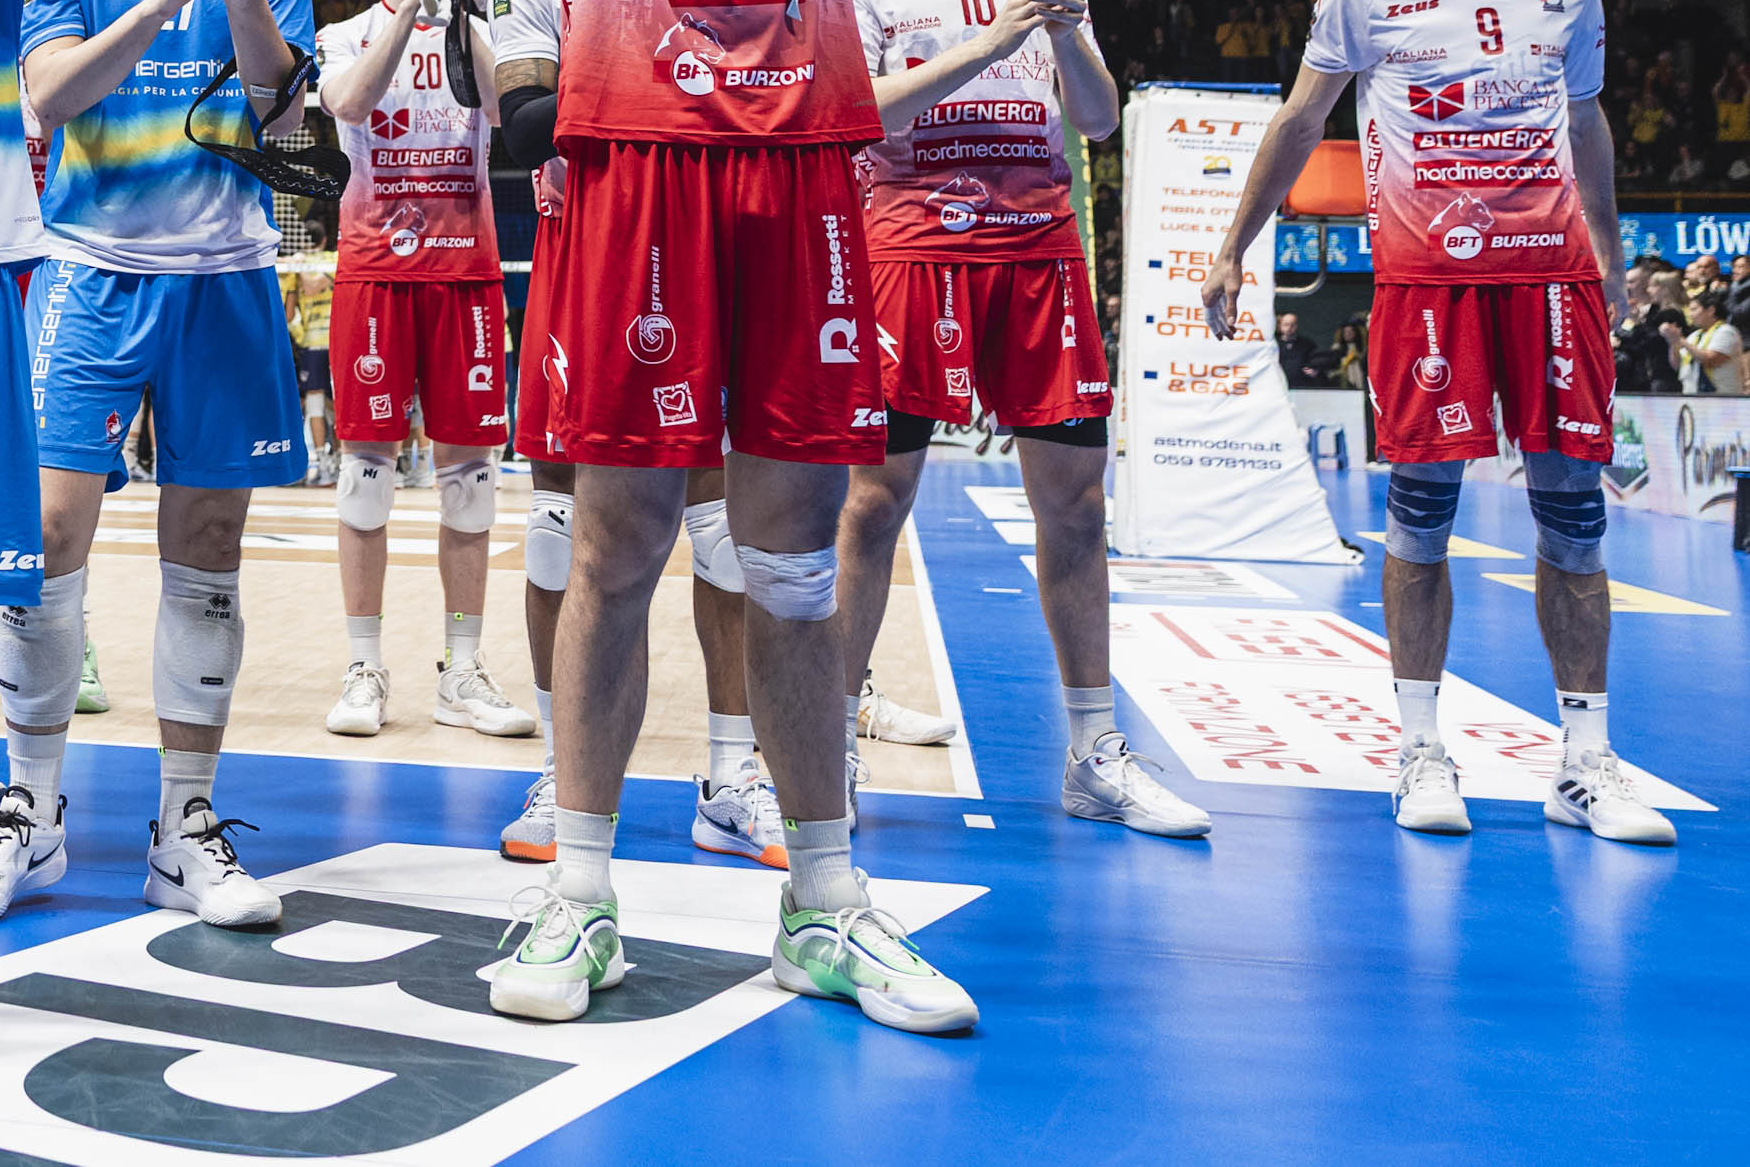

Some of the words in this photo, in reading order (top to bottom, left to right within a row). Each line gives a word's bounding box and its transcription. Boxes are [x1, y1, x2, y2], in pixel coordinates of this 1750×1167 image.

[1476, 7, 1505, 56] 9
[411, 53, 442, 90] 20
[143, 86, 166, 97] PER
[172, 87, 187, 97] LA
[1474, 79, 1536, 96] BANCA
[918, 103, 1042, 127] BLUENERGY
[377, 149, 470, 166] BLUENERG
[916, 139, 1050, 163] nordmeccanica
[1416, 162, 1560, 182] nordmeccanica
[1160, 223, 1201, 233] LUCE
[392, 237, 417, 249] BFT
[423, 237, 475, 249] BURZONI
[1446, 236, 1481, 248] BFT
[1491, 233, 1564, 249] BURZONI
[822, 215, 846, 305] Rossetti
[1168, 250, 1215, 266] TEL
[1168, 267, 1258, 286] FOA
[1156, 322, 1265, 342] OTTCA
[1169, 362, 1251, 379] LUCE
[1167, 379, 1251, 396] &GAS
[1556, 415, 1601, 436] Zeus
[1154, 436, 1283, 452] astmodena.it
[1154, 453, 1194, 466] 059
